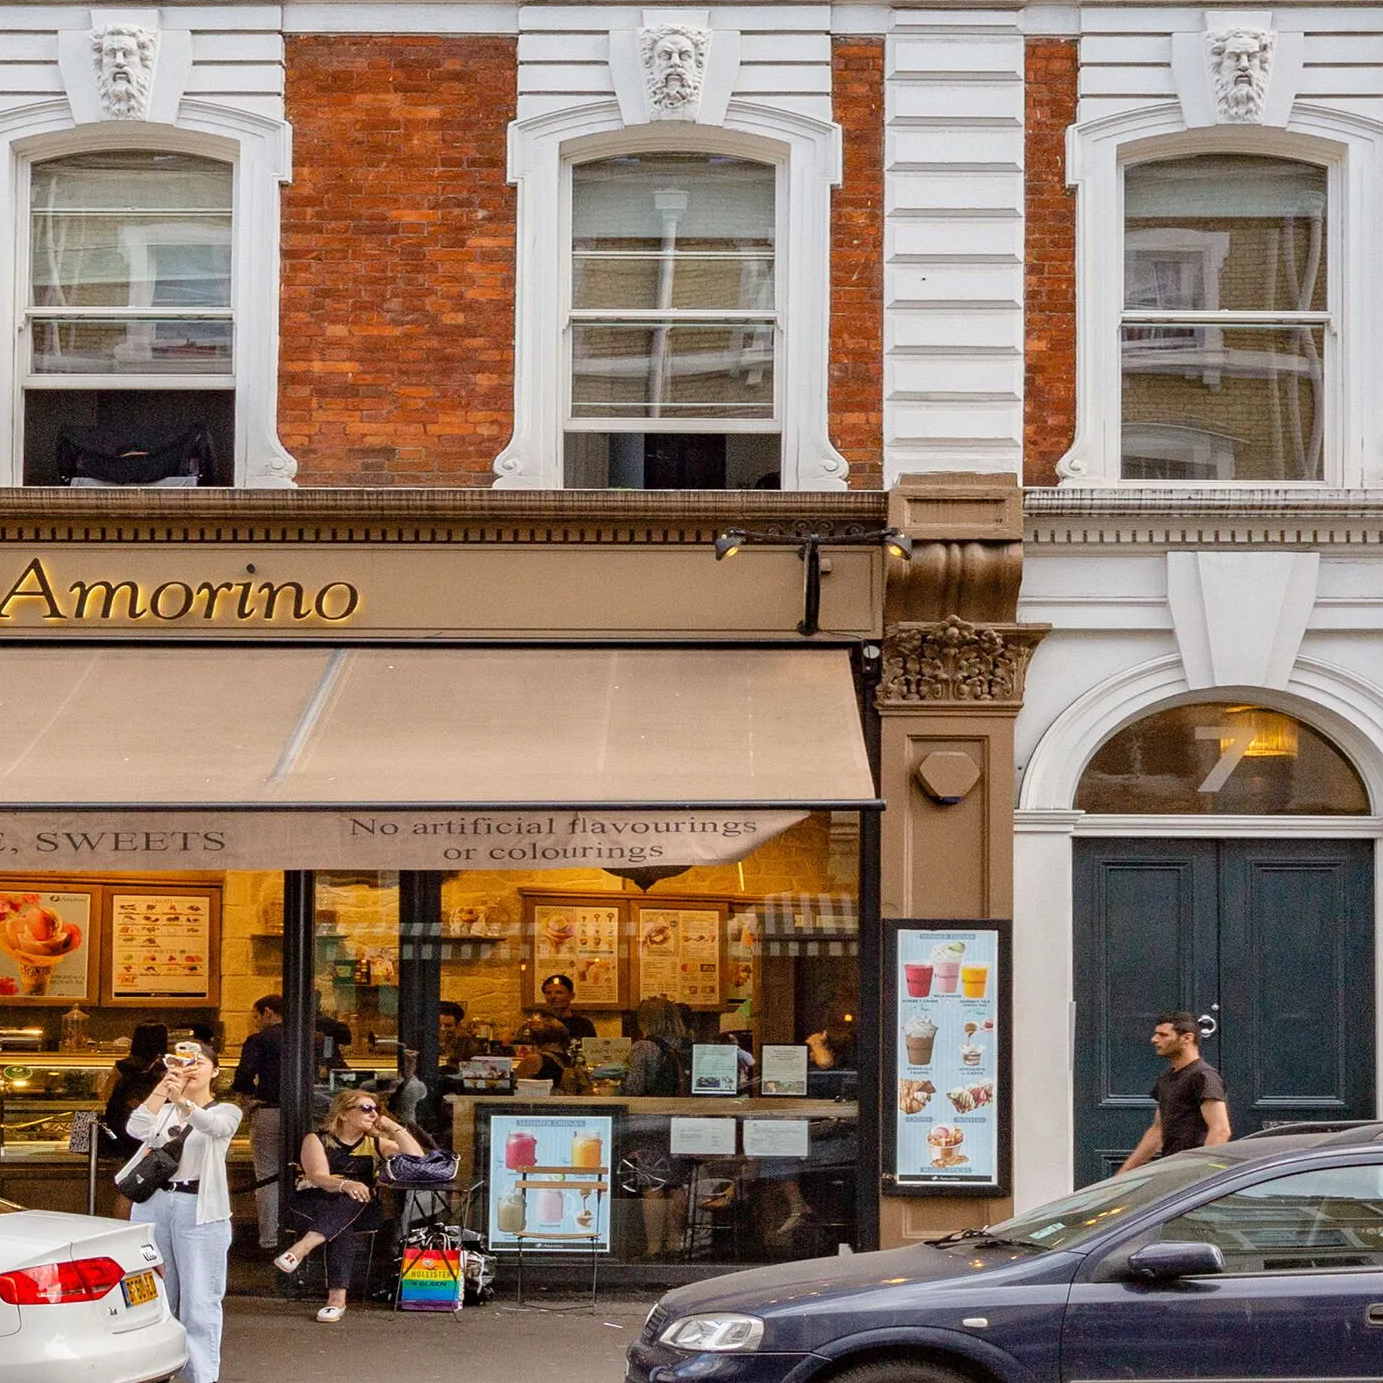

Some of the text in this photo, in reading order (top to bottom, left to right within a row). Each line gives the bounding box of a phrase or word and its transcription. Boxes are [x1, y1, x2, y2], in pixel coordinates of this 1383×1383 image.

[1194, 725, 1258, 792] 7
[349, 816, 758, 838] No artificial flavourings
[35, 831, 227, 853] SWEETS
[443, 842, 664, 863] or colourings
